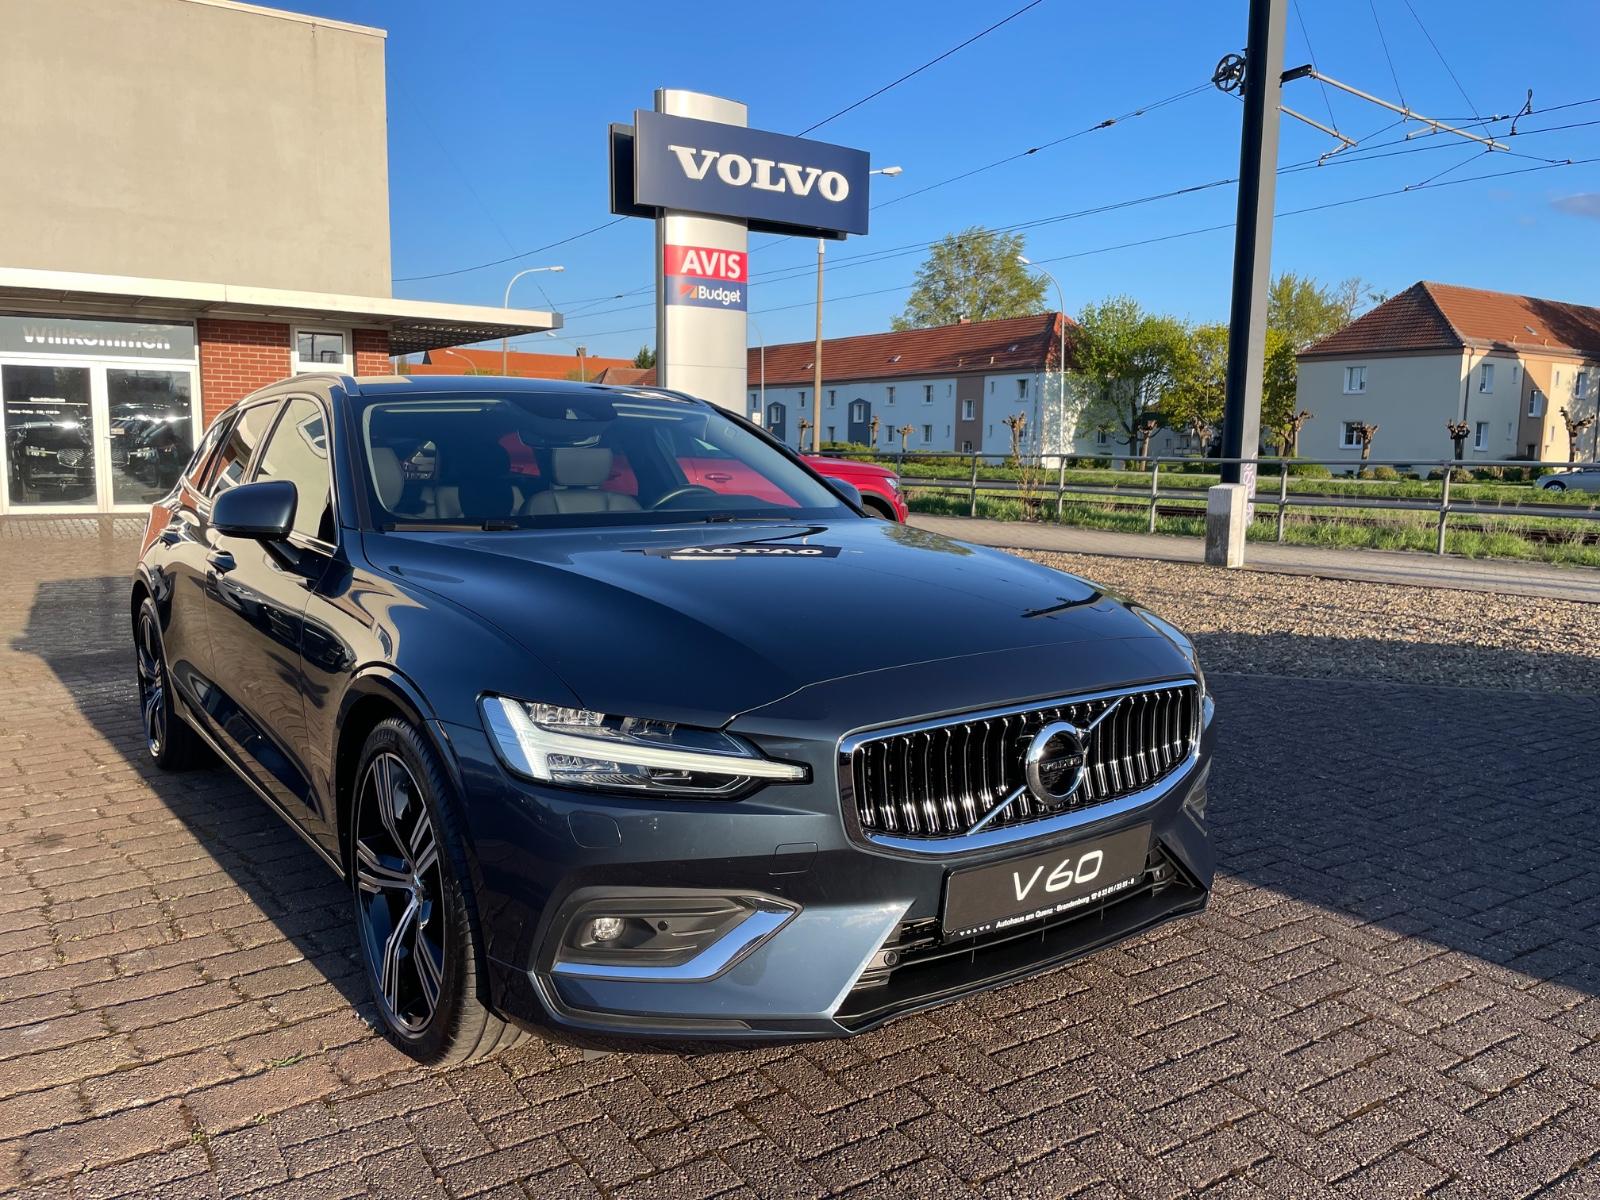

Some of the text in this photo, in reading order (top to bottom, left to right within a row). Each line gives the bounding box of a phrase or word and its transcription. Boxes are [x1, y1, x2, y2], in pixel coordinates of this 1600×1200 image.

[668, 145, 849, 202] VOLVO
[680, 249, 741, 279] AVIS
[699, 285, 741, 305] Budget
[23, 325, 170, 349] Willkommen
[1041, 757, 1082, 772] VOLVO
[996, 916, 1025, 929] Autohaus
[1025, 913, 1035, 921] am
[1035, 907, 1054, 919] Quenz
[1056, 896, 1090, 912] Brandenburg
